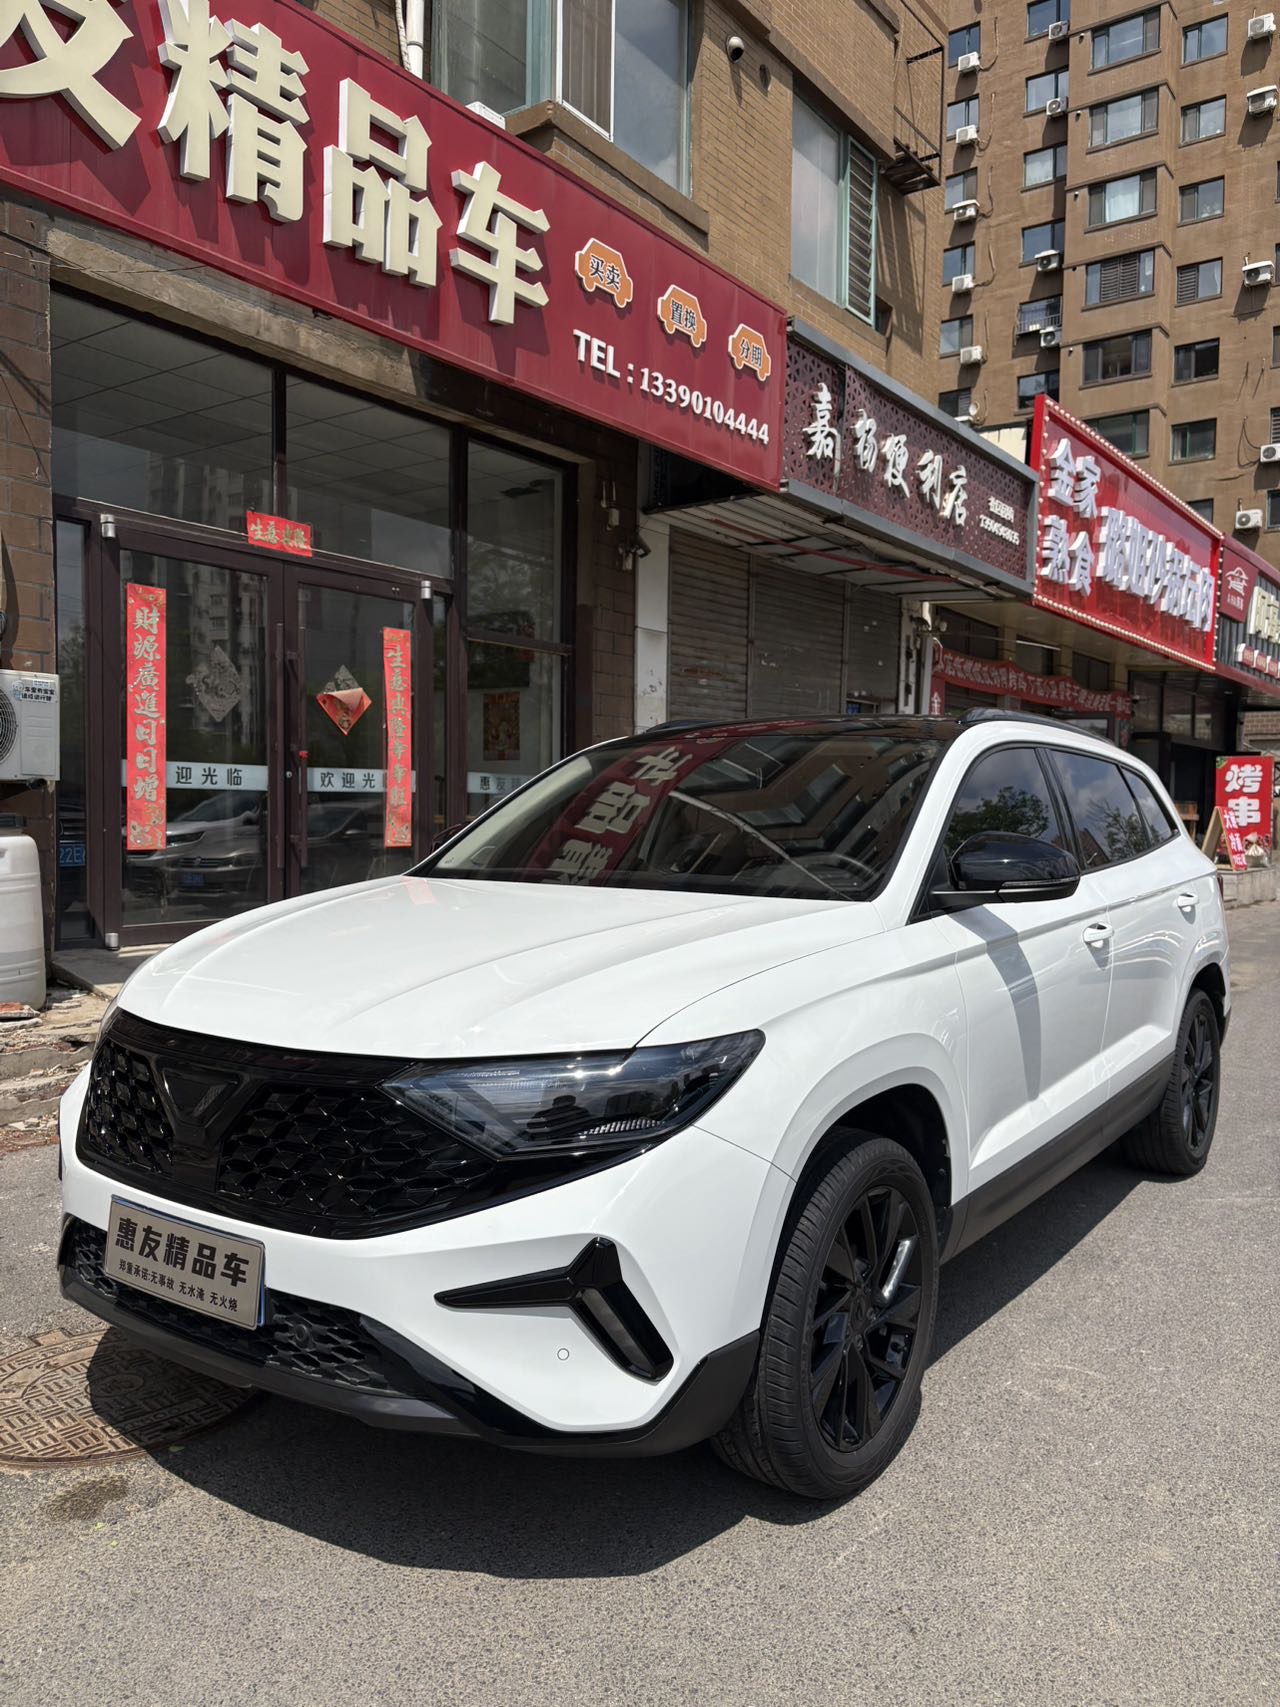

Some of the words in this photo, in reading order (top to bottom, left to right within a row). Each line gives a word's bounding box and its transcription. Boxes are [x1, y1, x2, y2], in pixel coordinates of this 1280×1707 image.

[587, 256, 622, 292] 买卖
[669, 299, 698, 333] 置换
[738, 337, 763, 368] 分期
[1047, 438, 1101, 518] 金家
[1040, 515, 1095, 597] 熟食
[319, 771, 387, 789] 欢迎光
[1225, 764, 1263, 826] 烤串
[115, 1216, 250, 1288] 惠友精品车
[178, 1281, 205, 1302] 无水淹
[209, 1290, 238, 1313] 无火烧
